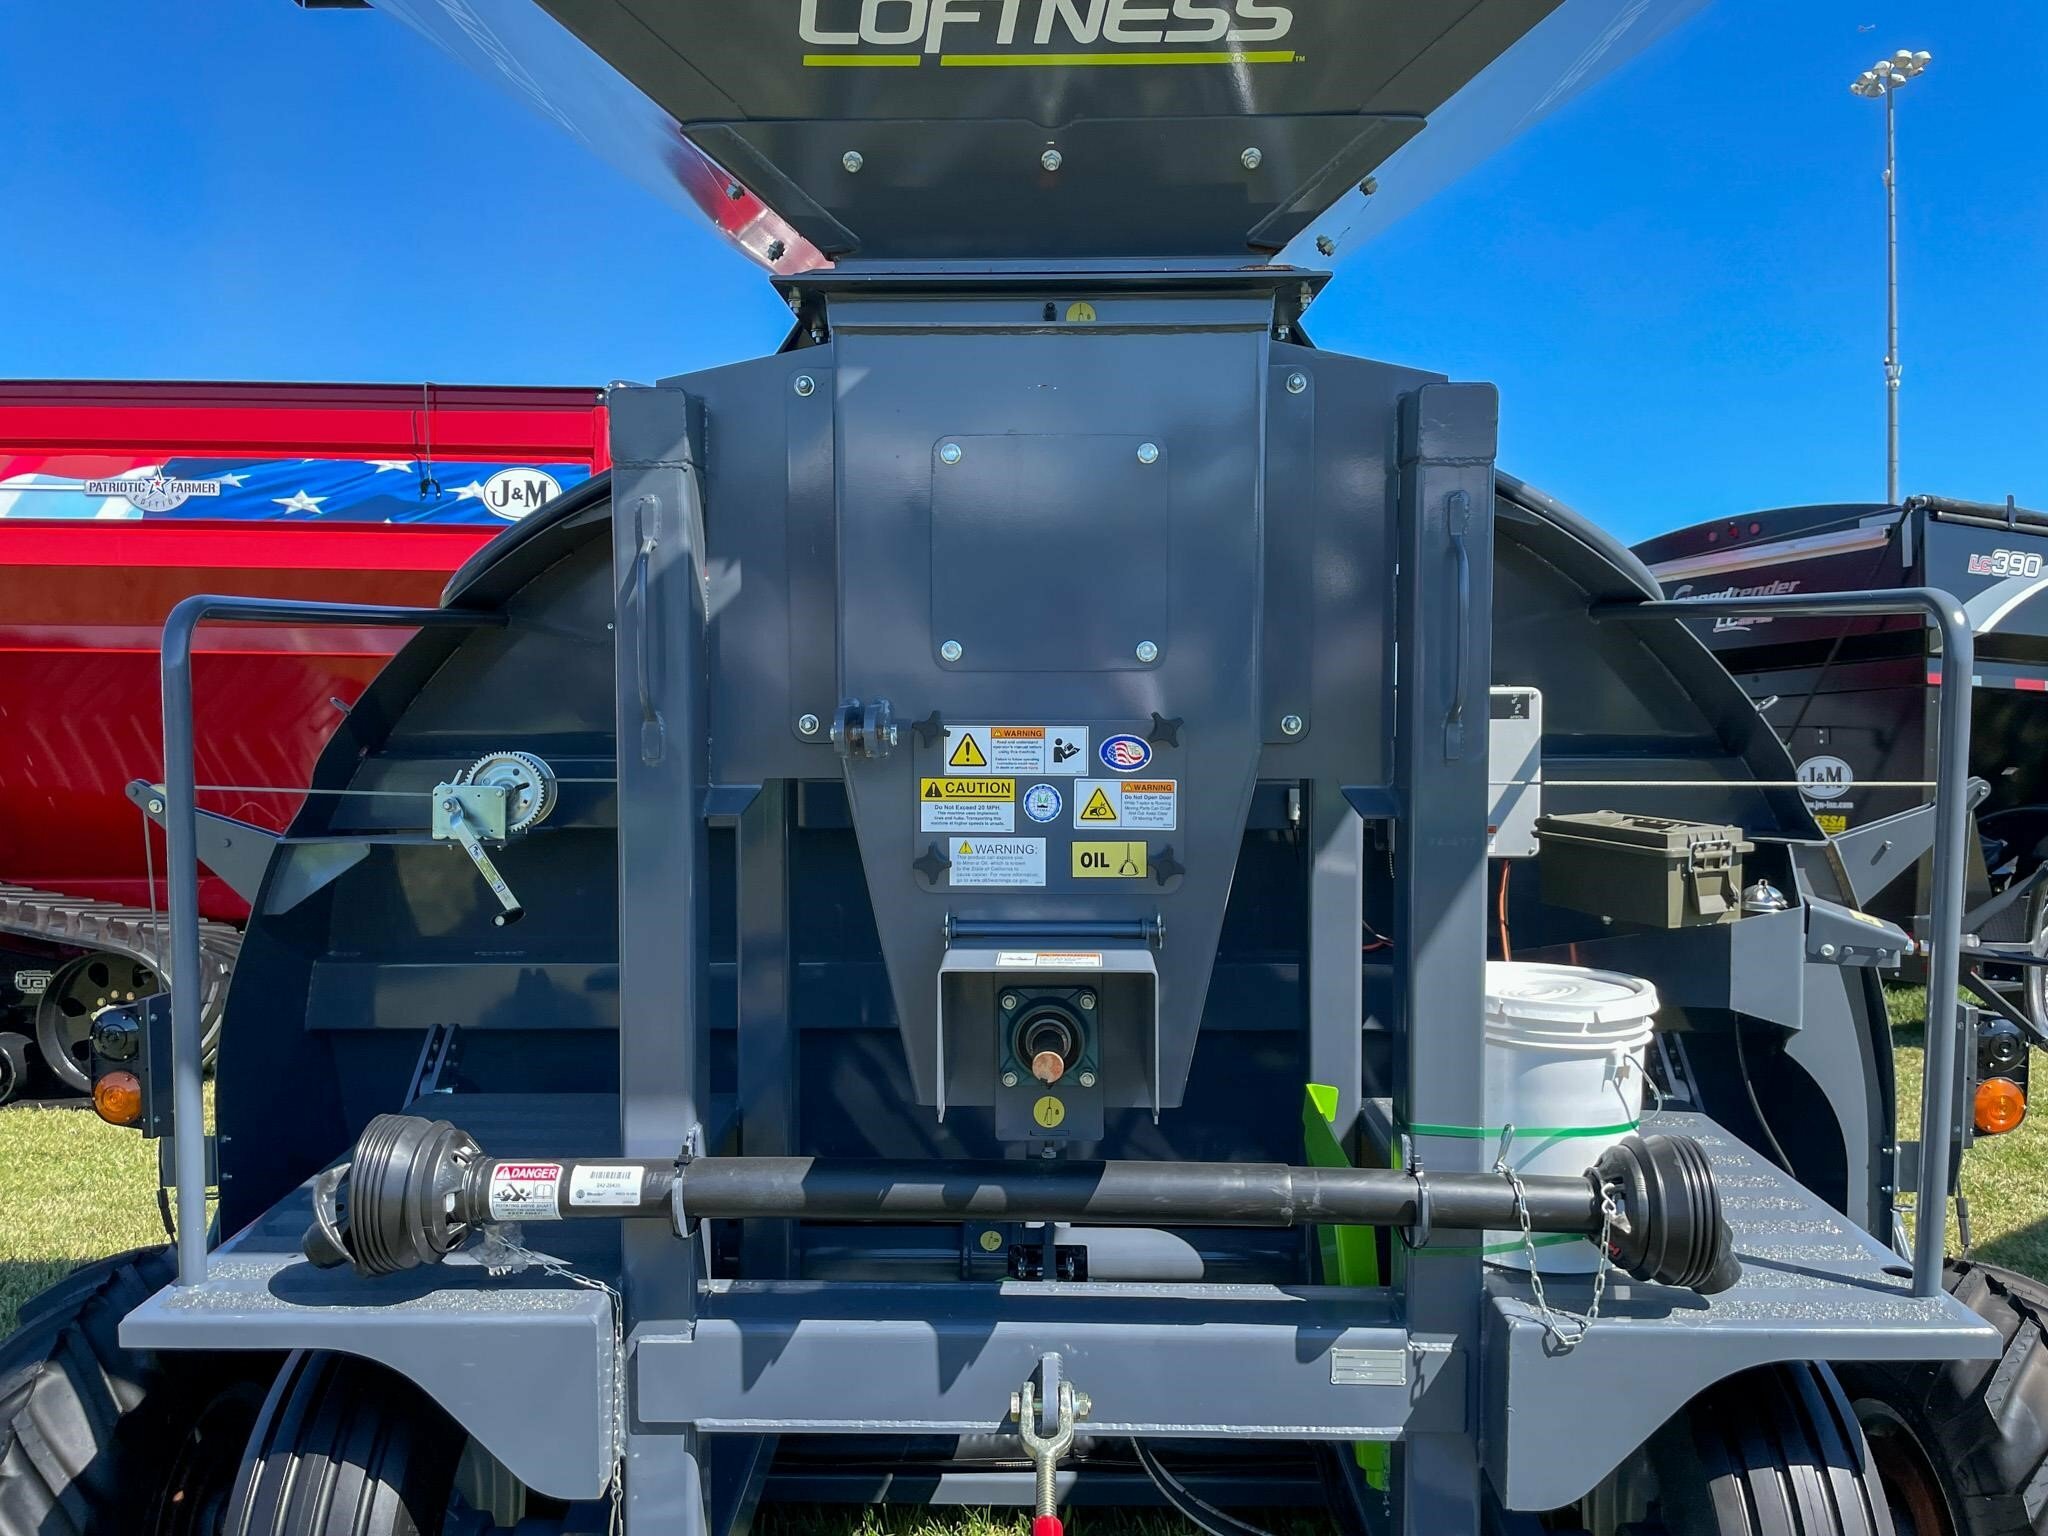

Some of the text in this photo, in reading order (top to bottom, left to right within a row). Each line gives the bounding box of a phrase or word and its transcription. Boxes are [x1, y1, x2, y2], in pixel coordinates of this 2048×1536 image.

[88, 481, 146, 493] PATRIOTIC
[170, 482, 216, 494] FARMER
[490, 479, 549, 508] J&M
[132, 493, 182, 508] EDITION
[1968, 549, 2043, 578] LC390
[1003, 729, 1042, 737] WARNING
[1802, 766, 1842, 789] J&M
[945, 782, 1011, 794] CAUTION
[975, 844, 1038, 854] WARNING:
[1080, 852, 1110, 868] OIL
[511, 1167, 558, 1180] DANGER
